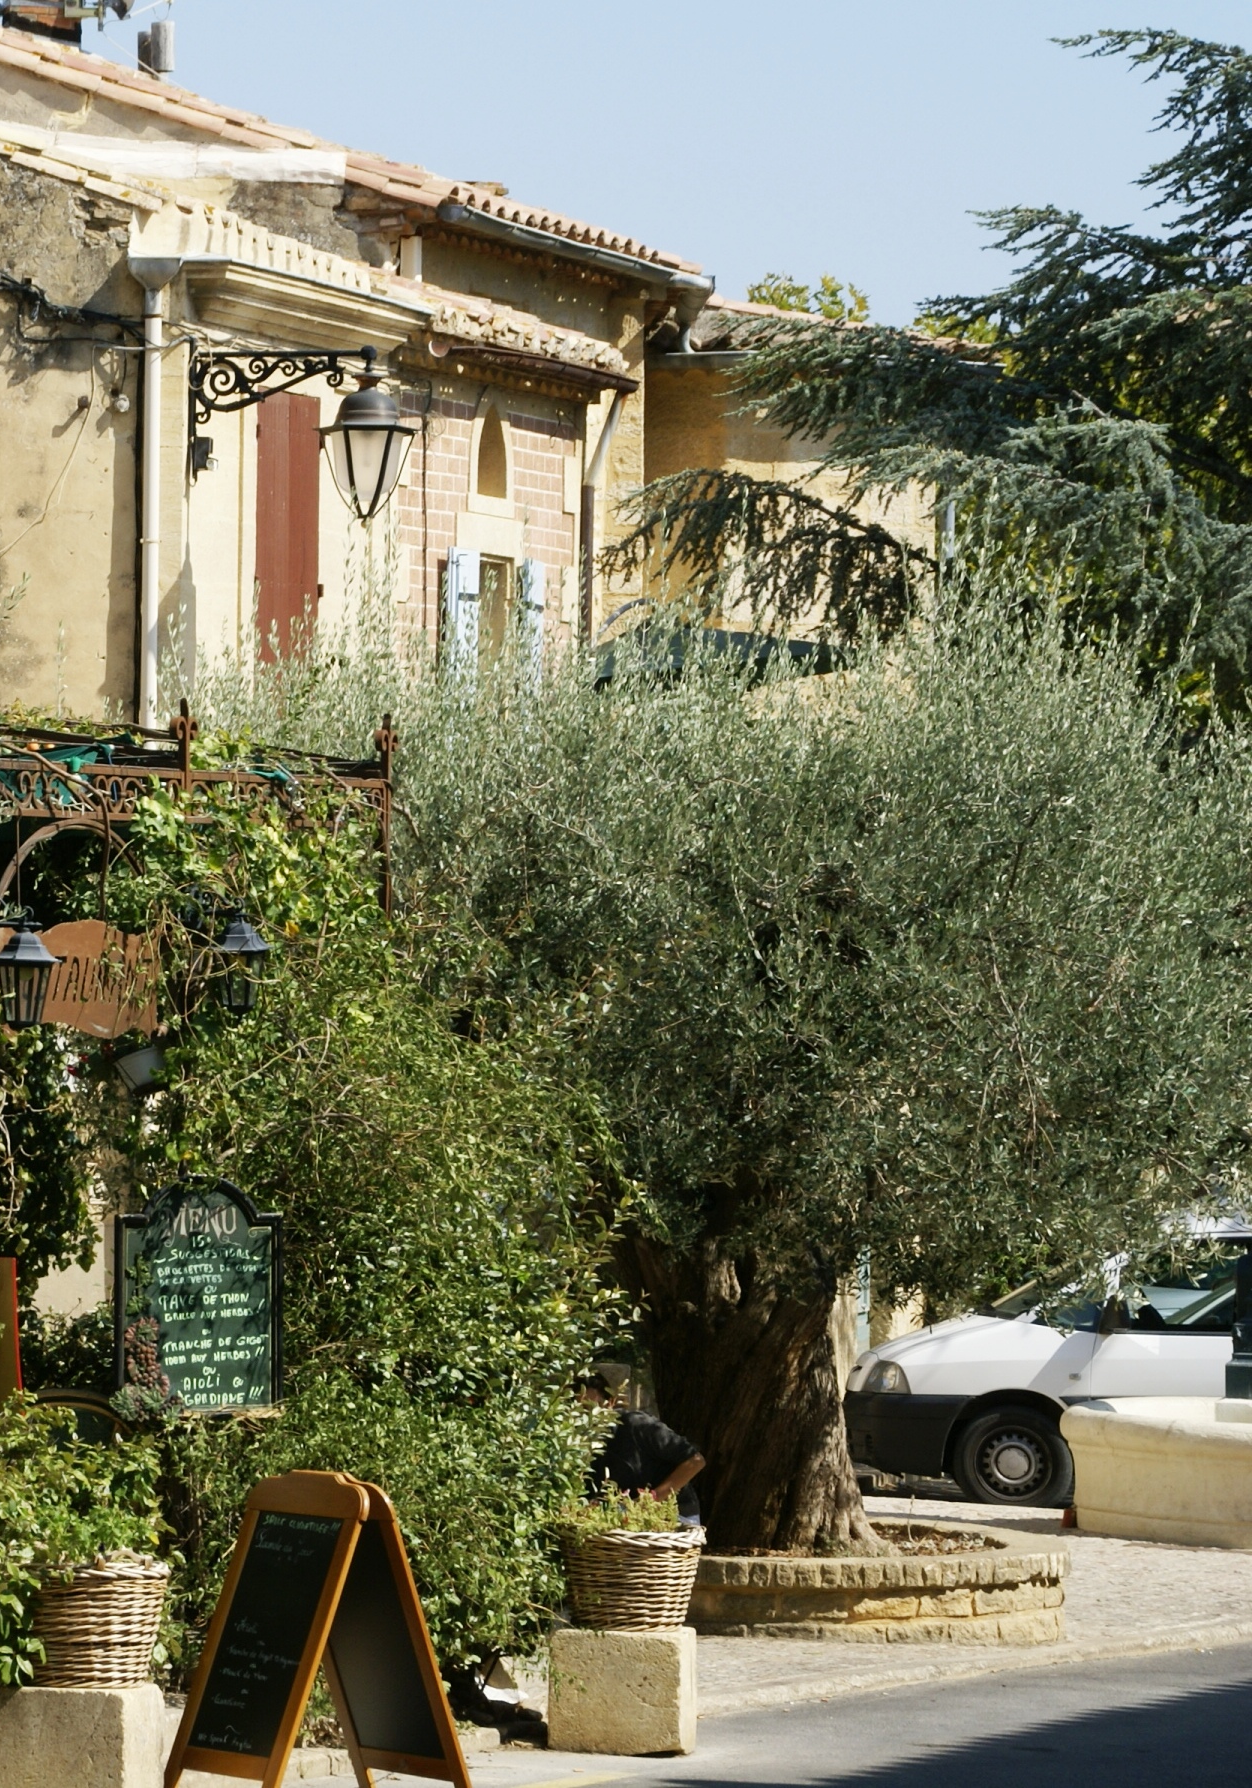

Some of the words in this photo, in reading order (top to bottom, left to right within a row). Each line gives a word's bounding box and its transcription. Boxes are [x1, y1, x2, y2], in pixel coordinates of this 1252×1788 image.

[159, 1202, 238, 1243] MENU
[169, 1248, 251, 1262] SUGGESTIONS
[204, 1285, 217, 1295] OU
[202, 1294, 218, 1305] DE
[220, 1292, 250, 1305] THON
[161, 1339, 213, 1353] TRANCHE
[217, 1337, 232, 1347] DE
[236, 1333, 269, 1346] GIGOT
[213, 1350, 251, 1362] HERBES
[184, 1391, 246, 1407] GARDIANE
